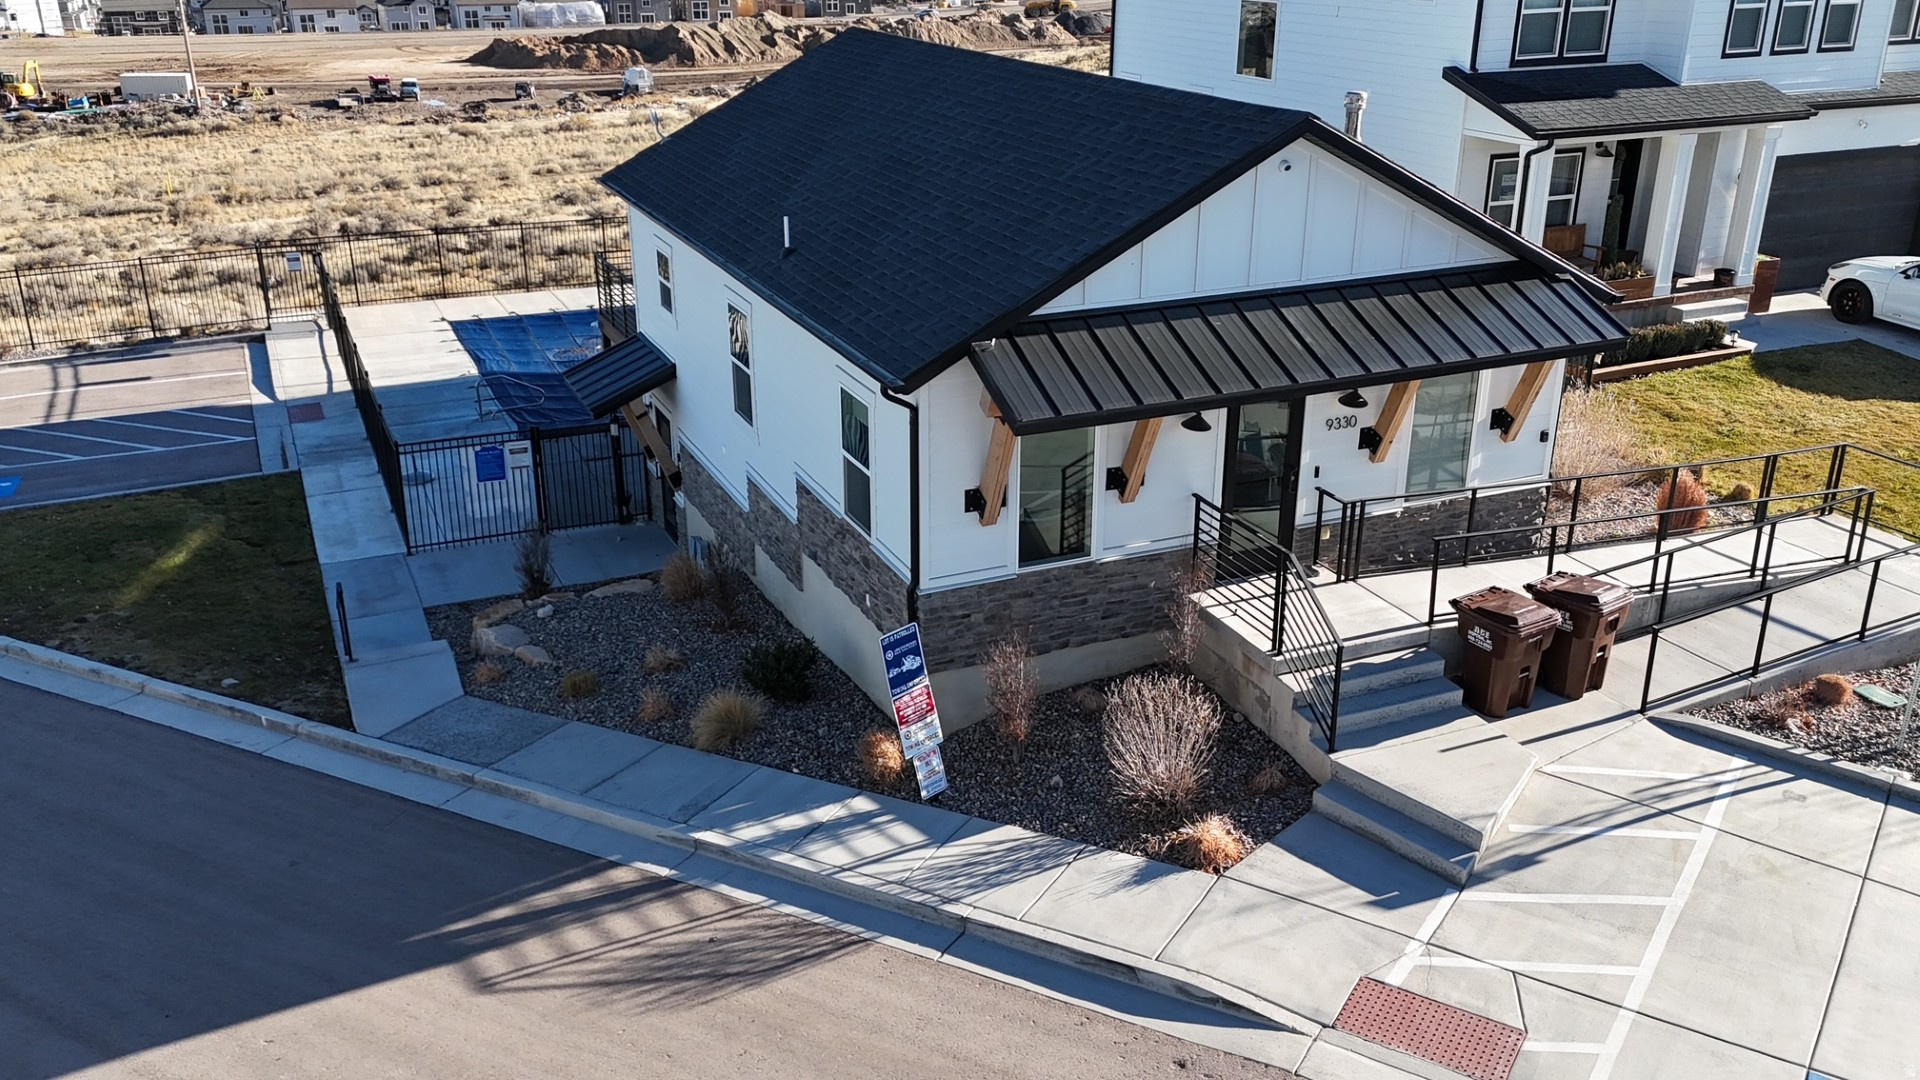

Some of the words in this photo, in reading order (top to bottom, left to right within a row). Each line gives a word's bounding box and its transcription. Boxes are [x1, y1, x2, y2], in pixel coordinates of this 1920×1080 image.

[1326, 415, 1357, 431] 9330
[882, 638, 890, 646] LOT
[894, 626, 916, 640] PATROLLED
[1474, 625, 1490, 639] ACE
